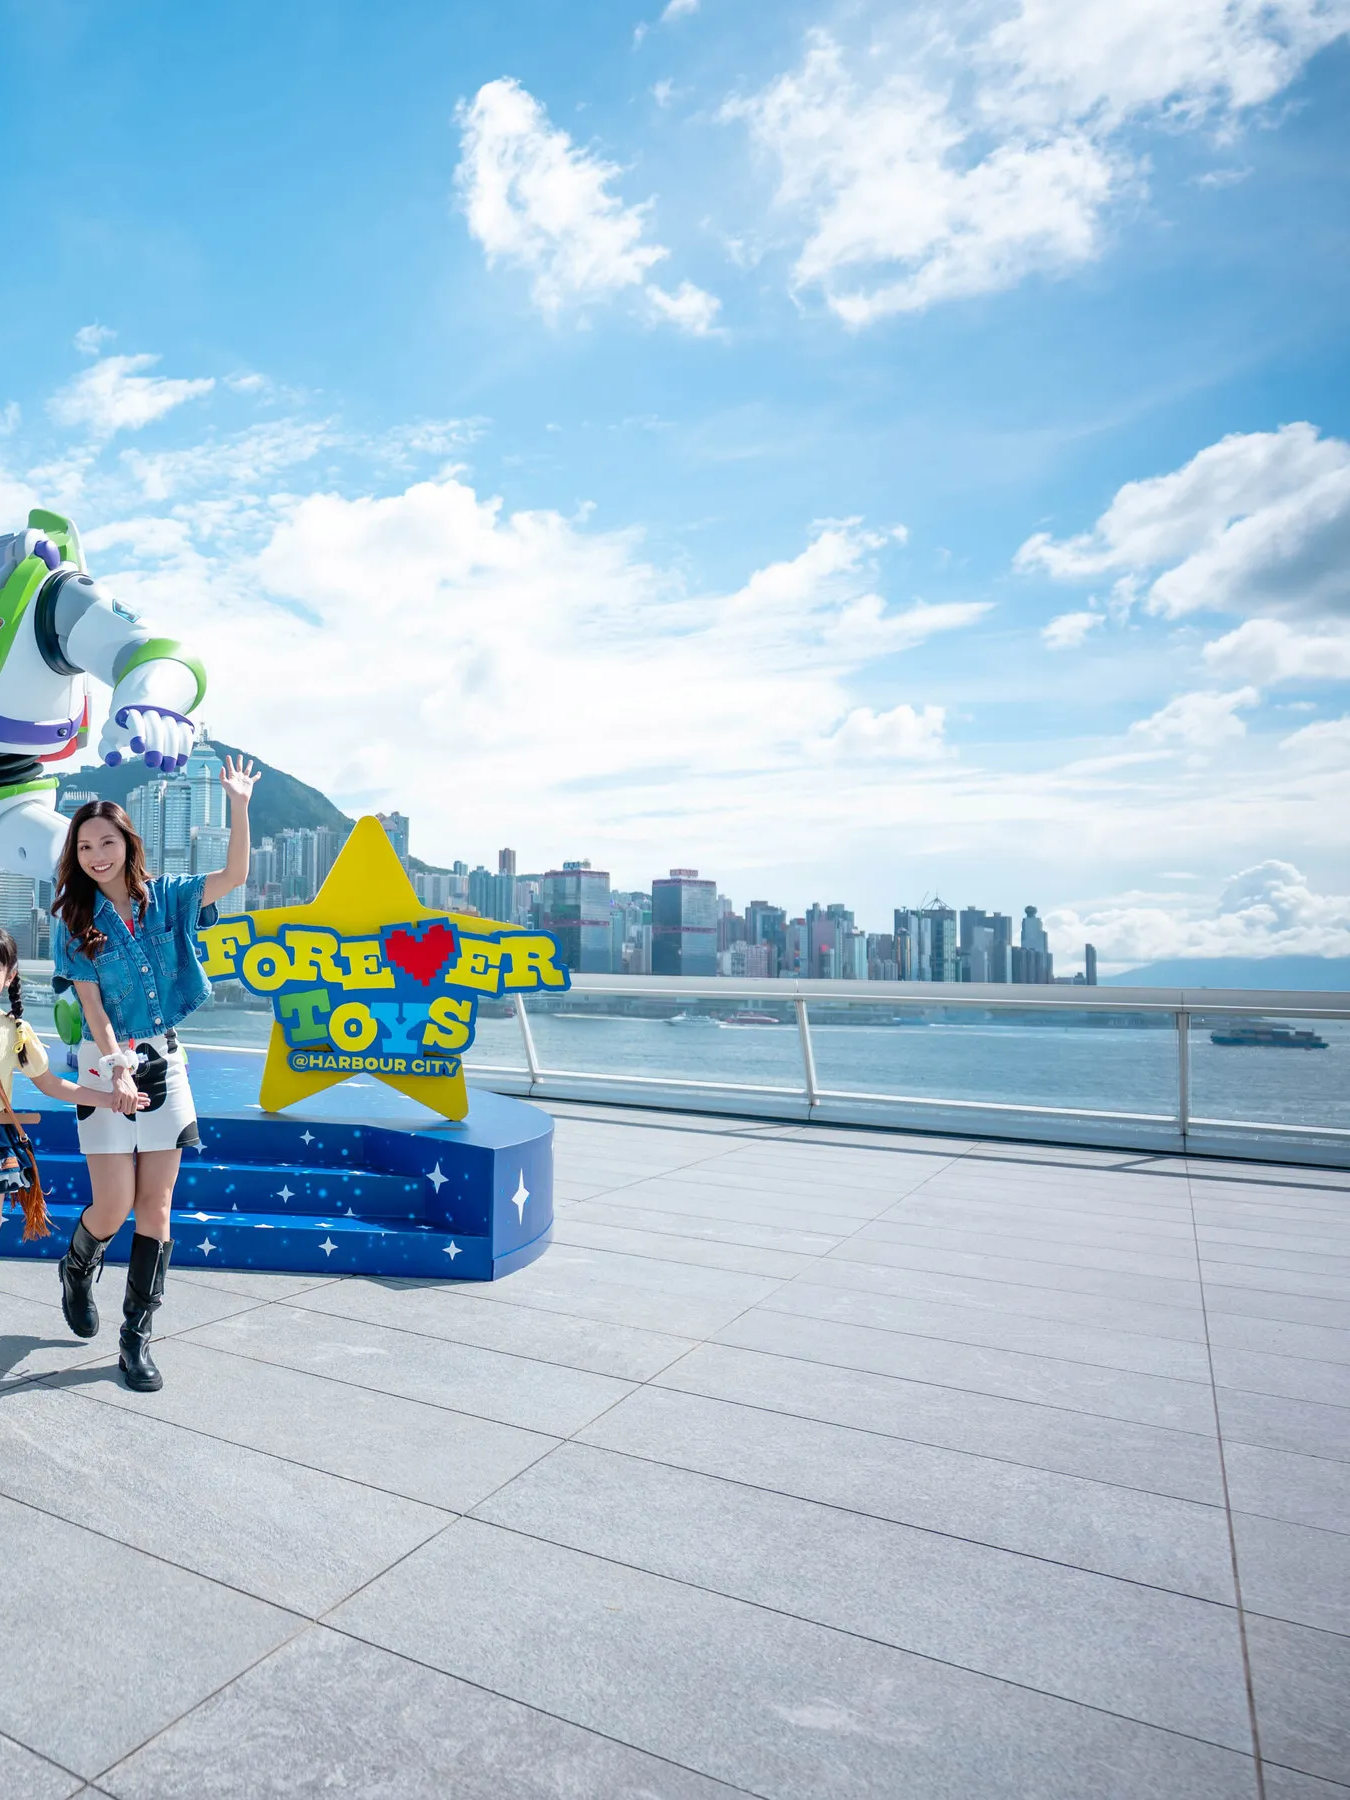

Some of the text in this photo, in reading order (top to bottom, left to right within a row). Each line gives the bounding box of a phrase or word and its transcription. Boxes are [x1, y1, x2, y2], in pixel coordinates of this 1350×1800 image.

[278, 988, 472, 1054] TOYS
[292, 1053, 457, 1075] @HARBOUR CITY
